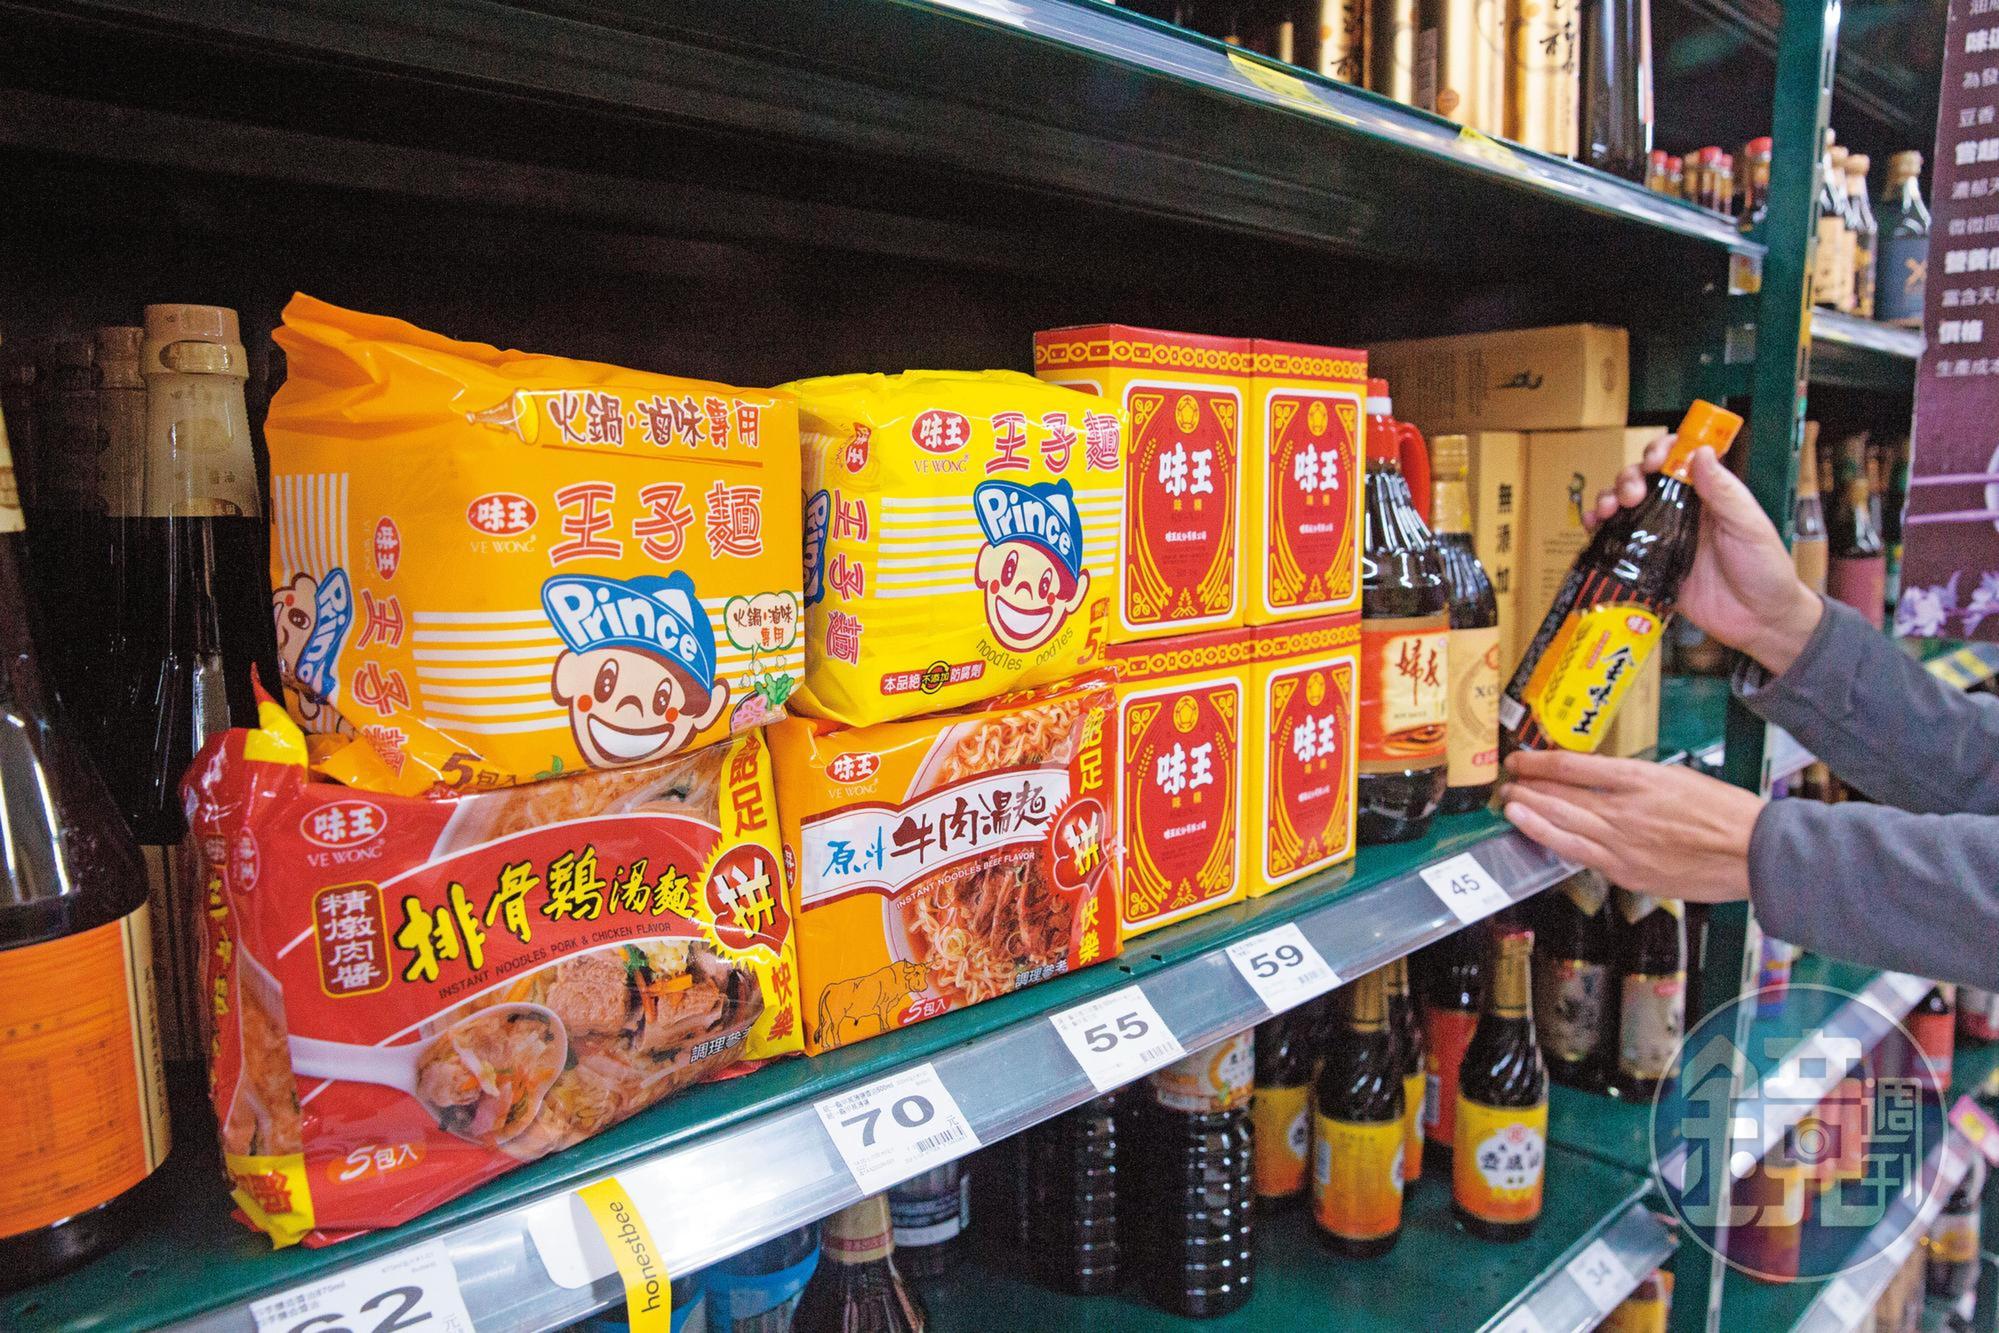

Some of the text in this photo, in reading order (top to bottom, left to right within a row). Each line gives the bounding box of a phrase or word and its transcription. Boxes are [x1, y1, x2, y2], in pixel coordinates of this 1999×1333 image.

[920, 413, 966, 448] 味王
[984, 409, 1121, 475] 王子麵
[914, 458, 966, 473] VE WONG
[1158, 442, 1214, 496] 味王
[1294, 443, 1339, 493] 味王
[476, 498, 530, 530] 味王
[548, 479, 763, 567] 王子麵
[978, 488, 1071, 553] Prince
[470, 540, 535, 553] VE WONG
[825, 489, 869, 665] 王子麵
[299, 577, 347, 685] Princ
[547, 583, 698, 662] Prince
[976, 637, 1023, 671] noodles
[1293, 714, 1335, 763] 味王
[828, 782, 877, 800] VE WONG
[832, 754, 875, 782] 味王
[1156, 742, 1214, 795] 味王
[313, 806, 377, 842] 味王
[822, 780, 1055, 877] 原汁 牛肉湯麵
[1065, 811, 1100, 877] 拼
[307, 846, 382, 868] VE WONG
[895, 851, 1036, 910] INSTANT NOODLES BEEF FLAVOR
[1451, 874, 1480, 895] 45
[713, 857, 775, 939] 拼
[766, 963, 794, 1041] 快樂
[1079, 895, 1100, 967] 快樂
[438, 922, 672, 999] INSTANT NOODLES PORK & CHICKEN FLAVOR
[1251, 944, 1303, 978] 59
[903, 998, 950, 1023] 5包入
[1083, 1011, 1149, 1053] 55
[840, 1094, 935, 1148] 70
[340, 1144, 418, 1181] 5包入
[609, 1201, 660, 1313] honestbee
